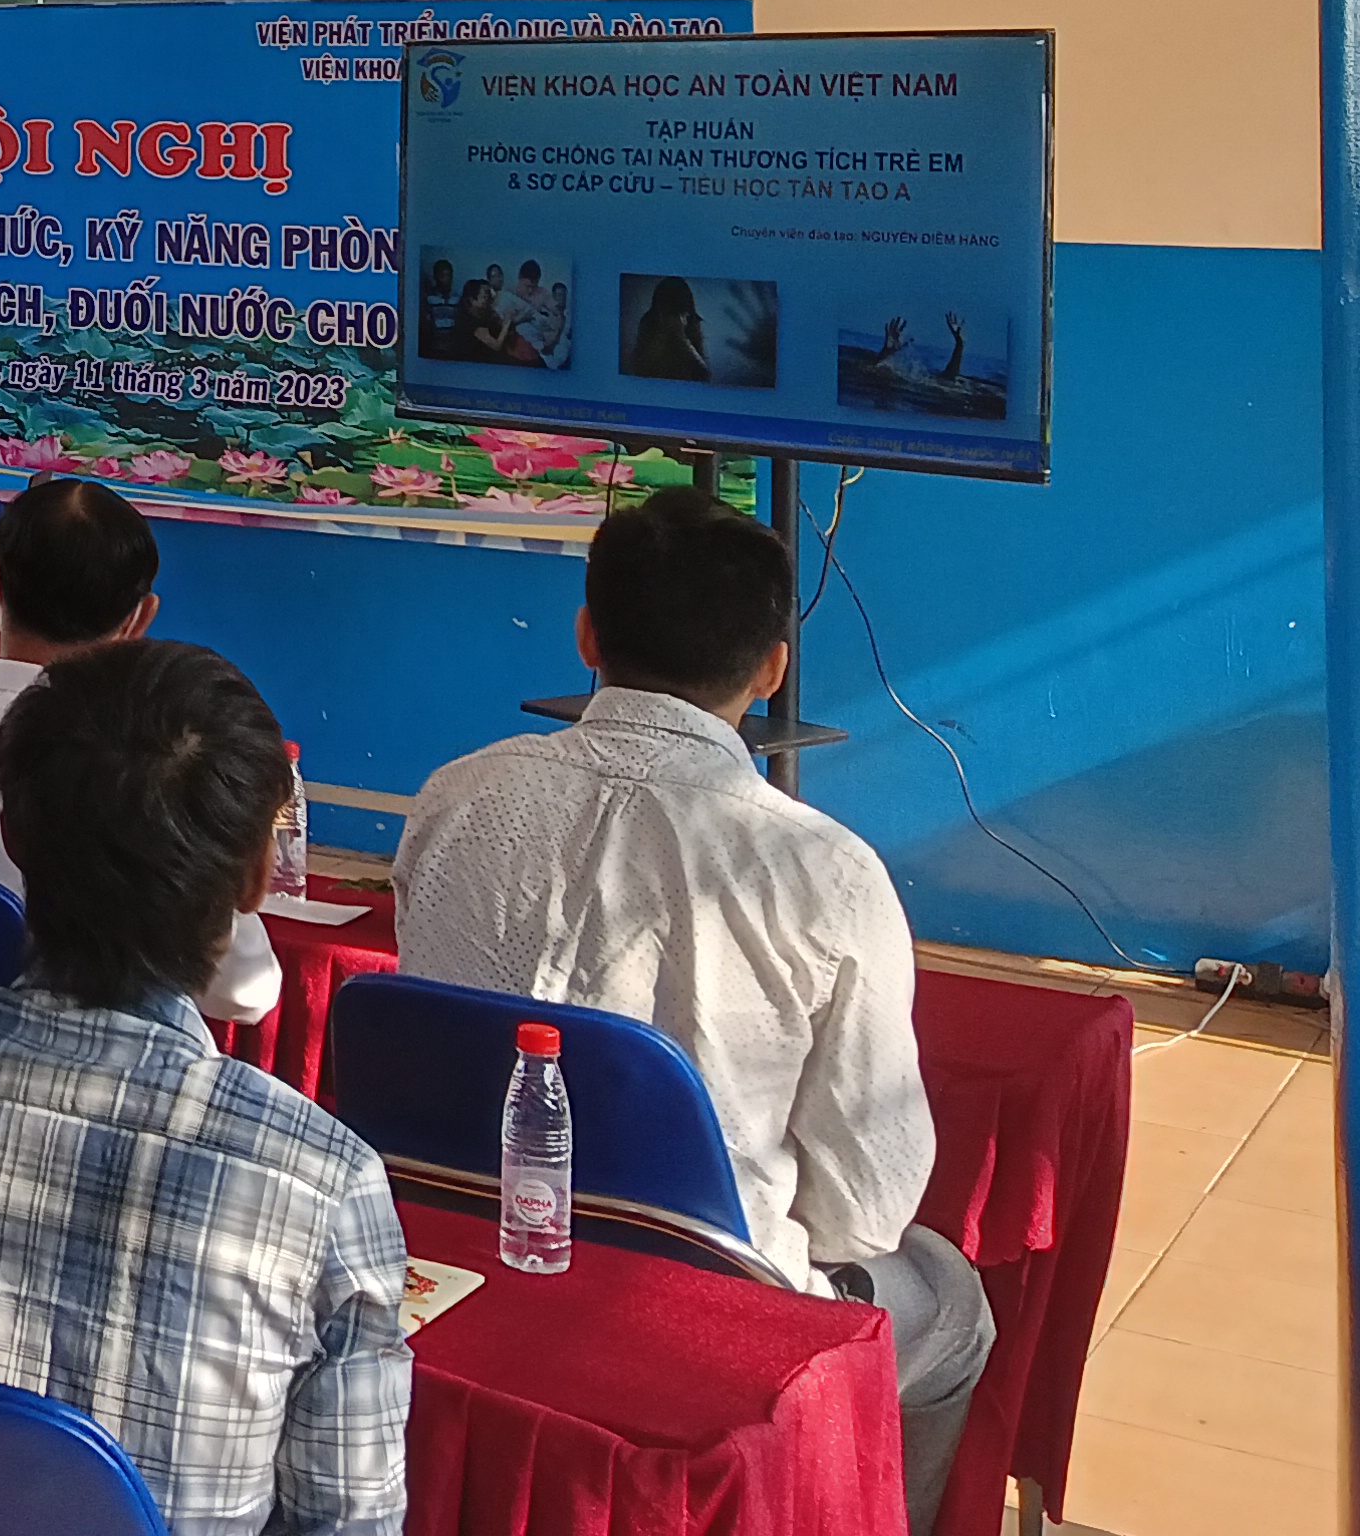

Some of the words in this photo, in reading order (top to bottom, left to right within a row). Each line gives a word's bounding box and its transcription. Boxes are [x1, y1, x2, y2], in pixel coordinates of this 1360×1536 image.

[256, 15, 307, 50] VIỆN
[314, 15, 372, 46] PHÁT
[379, 9, 448, 46] TRIỂN
[571, 13, 604, 37] VÀ
[300, 53, 349, 84] VIỆN
[481, 73, 536, 101] VIỆN
[544, 75, 616, 96] KHOA
[624, 75, 679, 102] HỌC
[688, 75, 725, 96] AN
[735, 69, 810, 96] TOÀN
[820, 72, 882, 102] VIỆT
[892, 73, 958, 96] NAM
[74, 120, 292, 195] NGHỊ
[468, 141, 536, 163] PHÒNG
[622, 148, 652, 165] TAI
[658, 148, 703, 171] NẠN
[710, 148, 808, 169] THƯƠNG
[815, 145, 867, 171] TÍCH
[929, 153, 963, 173] EM
[508, 172, 522, 190] &
[527, 172, 557, 191] SƠ
[733, 177, 781, 201] HỌC
[788, 175, 833, 200] TÂN
[841, 180, 889, 204] TẠO
[894, 181, 911, 202] A
[86, 209, 143, 262] KỸ
[155, 214, 270, 269] NĂNG
[282, 216, 399, 273] PHÒN
[68, 276, 168, 336] ĐUỐI
[179, 285, 296, 342] NƯỚC
[307, 299, 398, 349] CHO
[8, 355, 68, 392] ngày
[74, 358, 105, 390] 11
[112, 362, 182, 402] tháng
[190, 366, 208, 398] 3
[214, 370, 270, 404] năm
[276, 373, 347, 409] 2023
